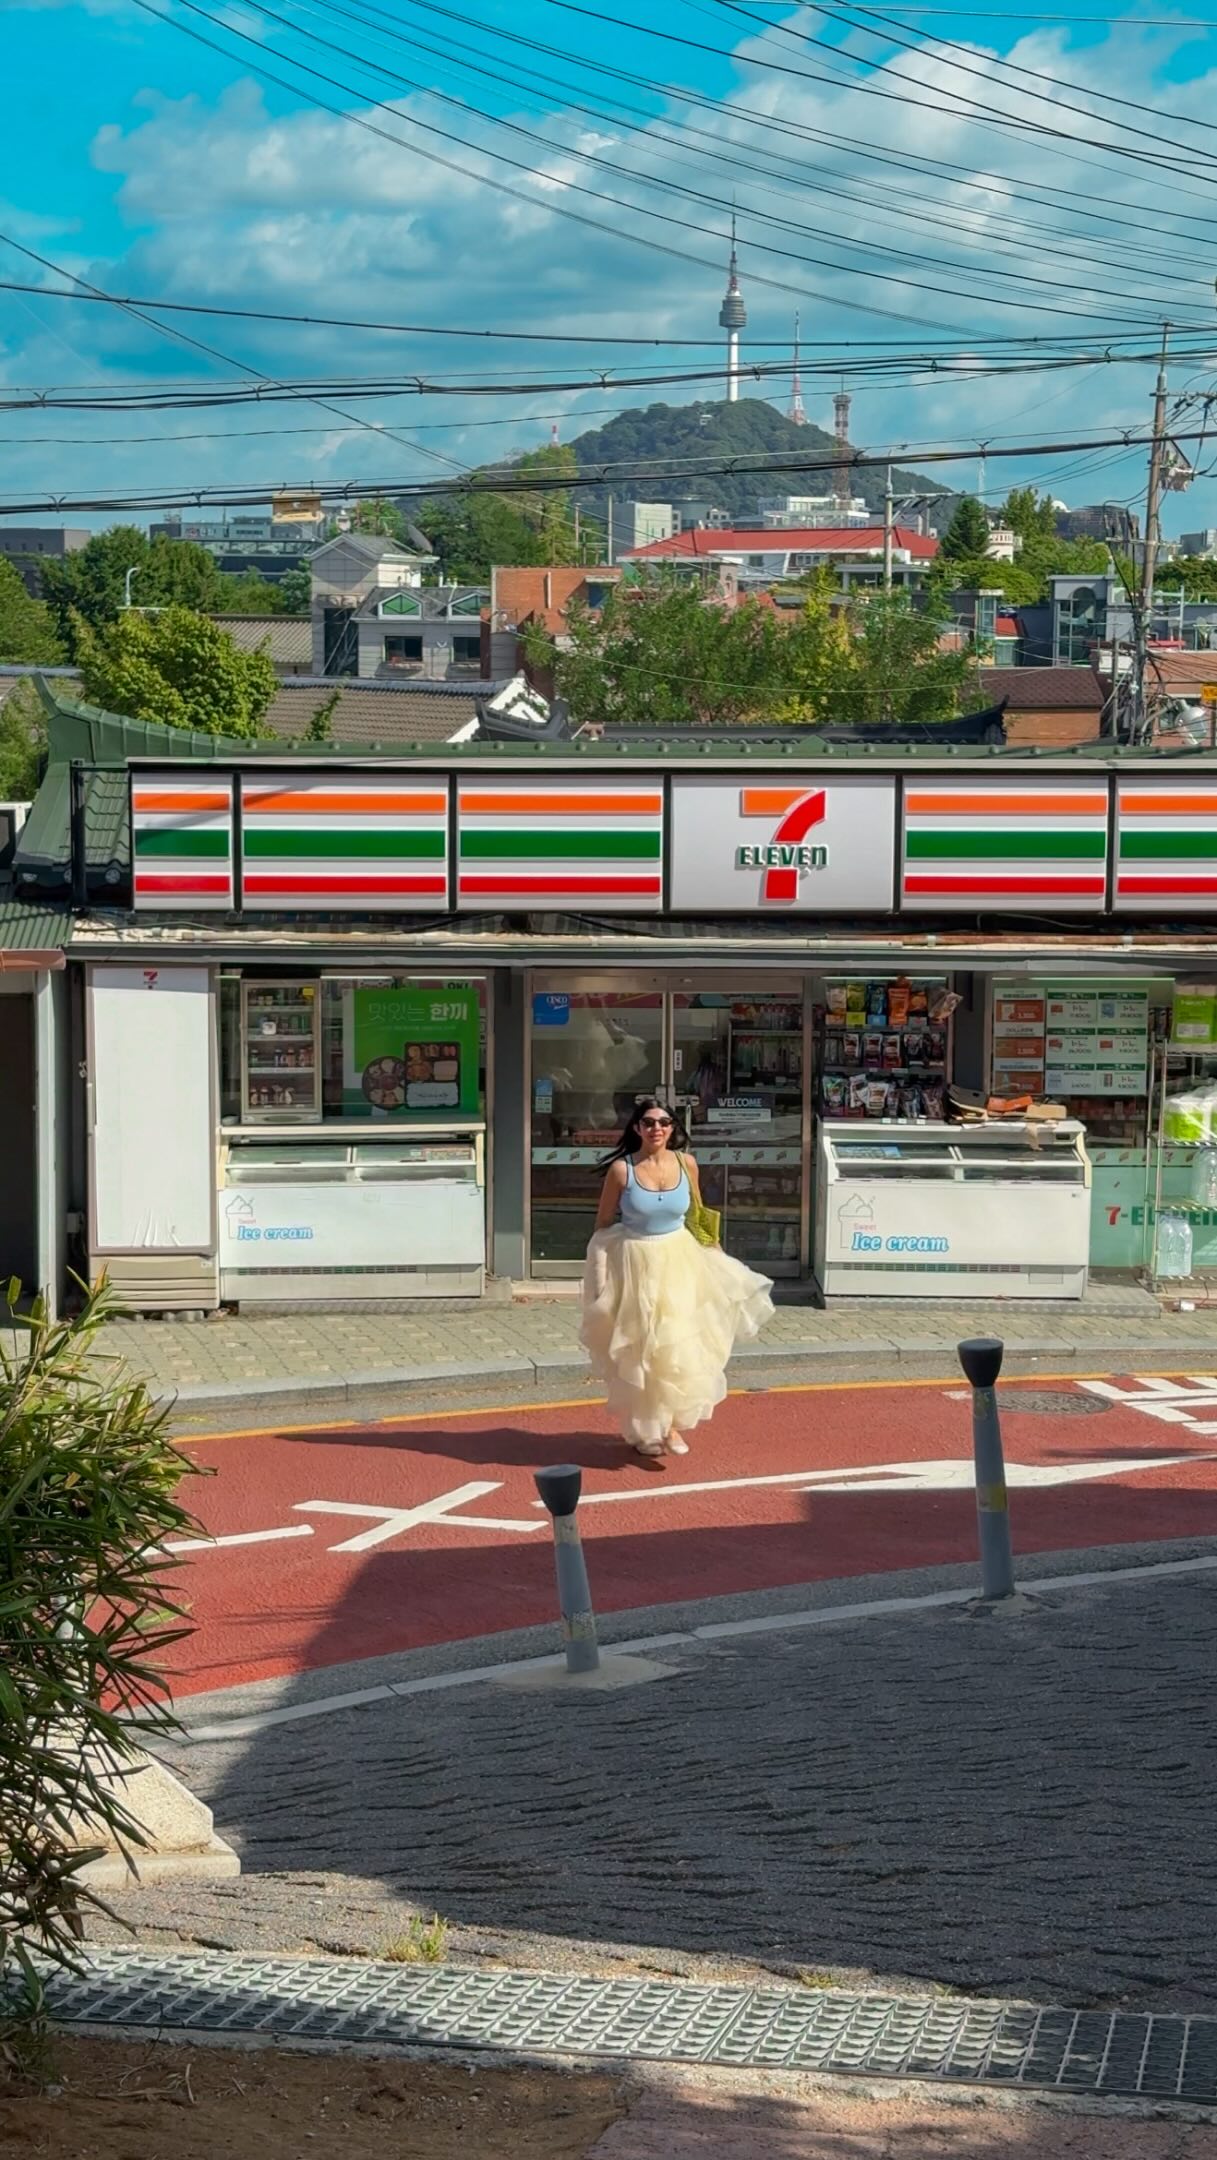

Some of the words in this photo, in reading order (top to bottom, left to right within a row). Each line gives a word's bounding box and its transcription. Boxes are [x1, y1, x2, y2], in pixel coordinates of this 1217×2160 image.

[742, 788, 827, 902] 7
[429, 1002, 468, 1021] 한끼
[717, 1097, 762, 1107] WELCOME
[237, 1225, 262, 1241] Ice
[263, 1226, 314, 1240] cream
[851, 1231, 882, 1251] Ice
[885, 1235, 950, 1252] cream
